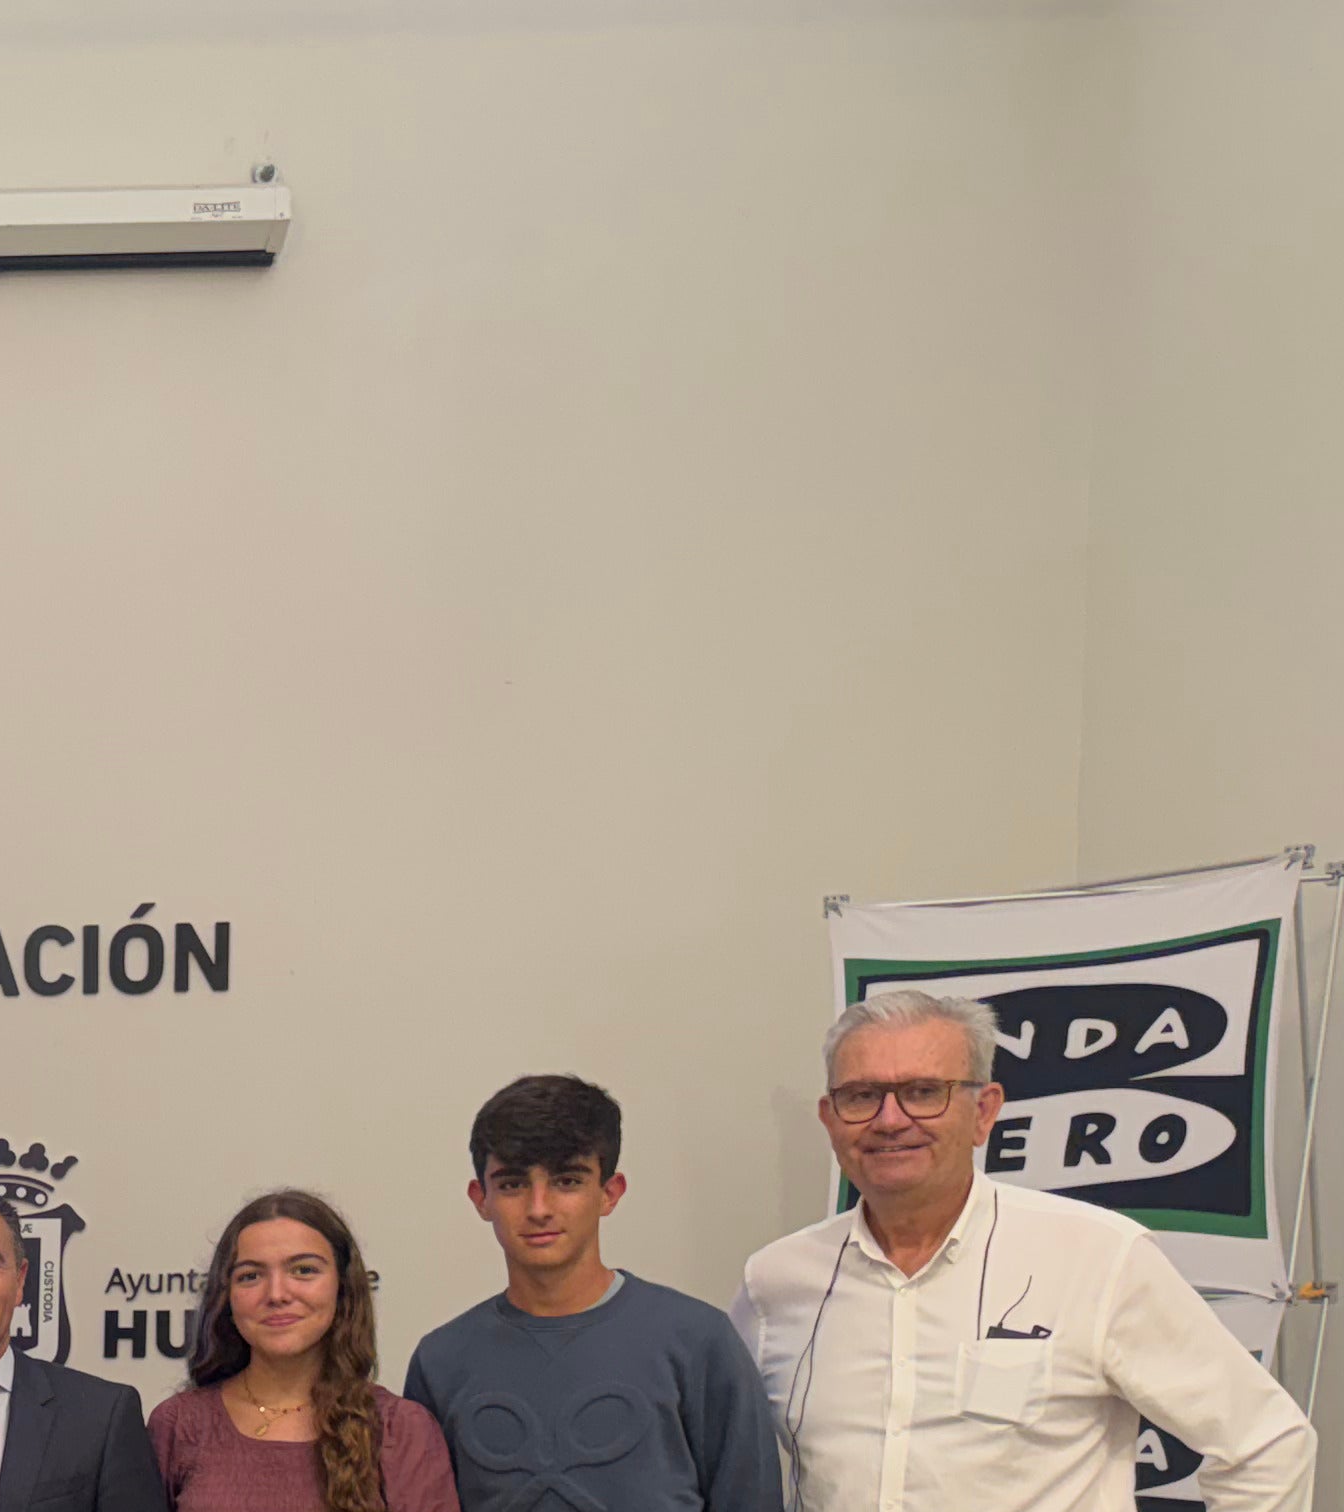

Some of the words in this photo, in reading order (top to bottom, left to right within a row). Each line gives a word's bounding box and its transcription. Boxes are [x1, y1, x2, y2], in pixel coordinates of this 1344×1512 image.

[995, 1006, 1190, 1060] NDA
[984, 1112, 1188, 1173] ERO
[42, 1260, 55, 1324] CUSTODIA
